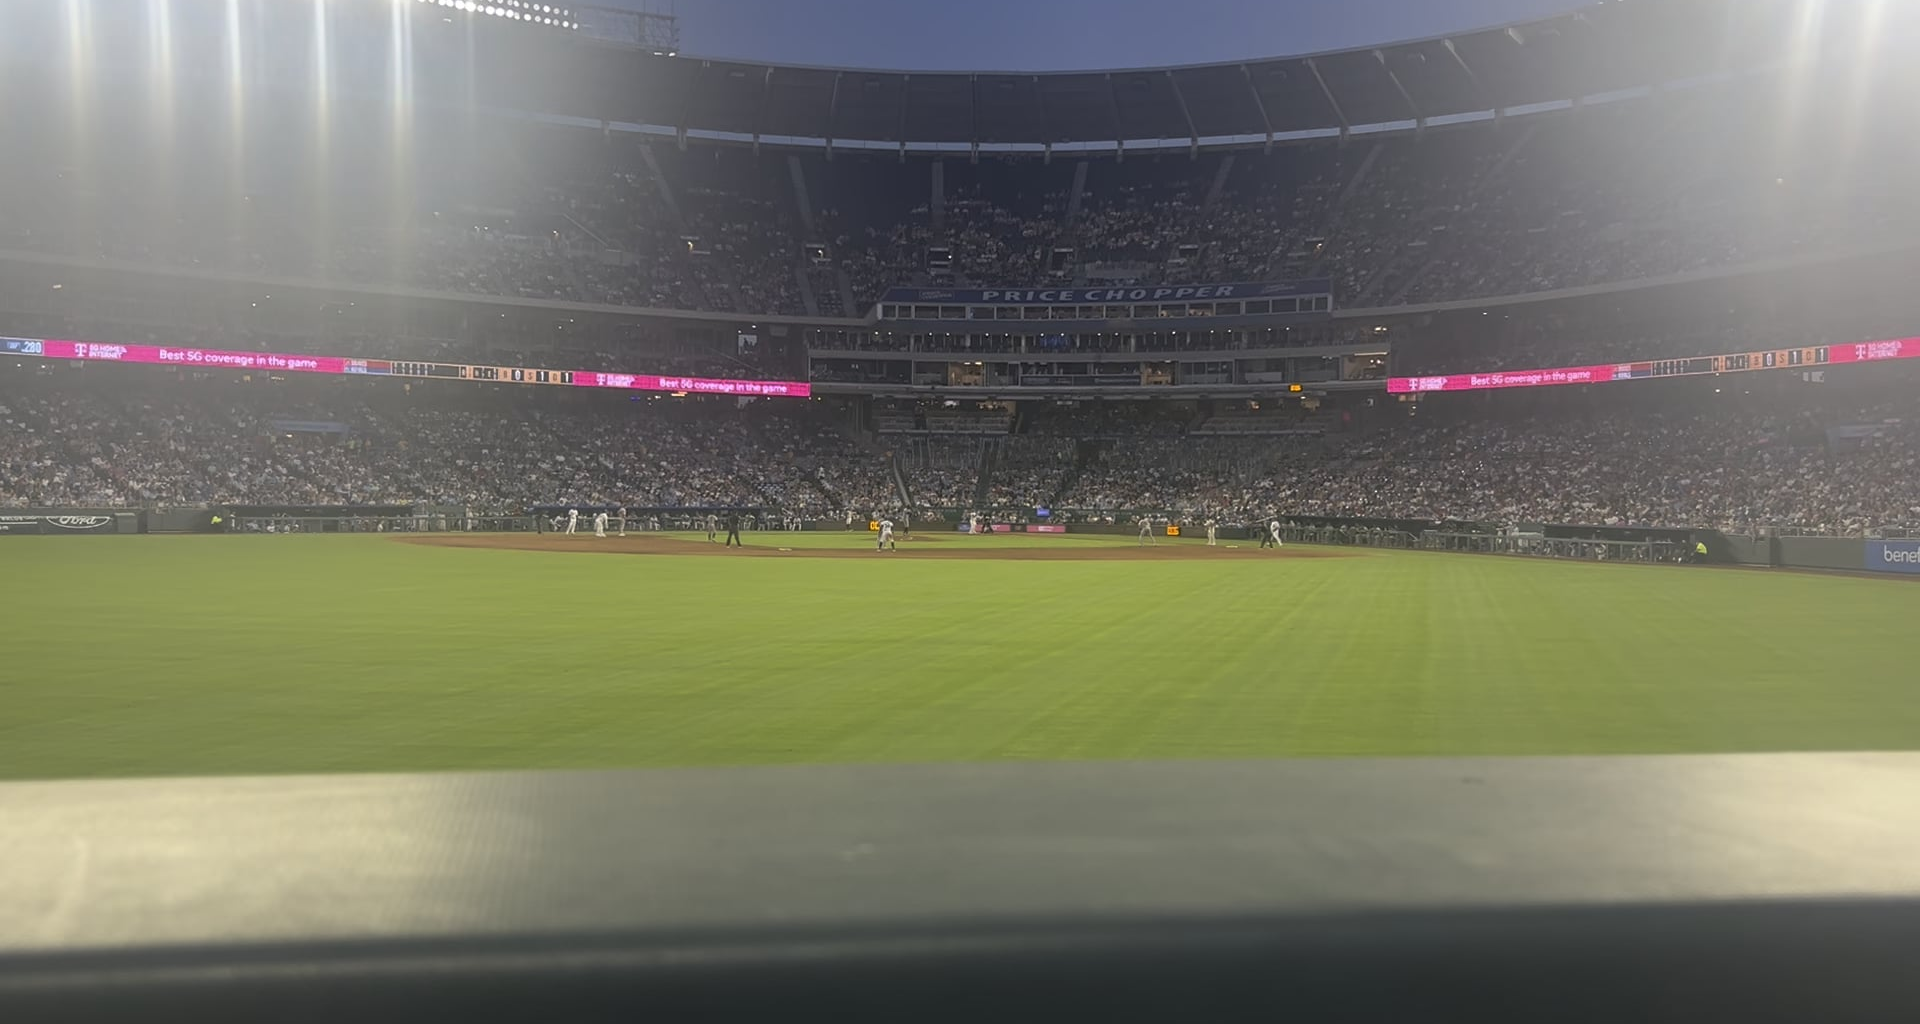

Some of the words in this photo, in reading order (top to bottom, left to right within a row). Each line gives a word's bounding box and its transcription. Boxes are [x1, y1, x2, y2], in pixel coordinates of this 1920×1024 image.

[982, 290, 1074, 301] PRICE
[1085, 285, 1235, 301] CHOPPER
[159, 349, 184, 360] Best
[187, 351, 202, 361] 5G
[204, 353, 254, 366] coverage
[256, 355, 266, 365] in
[267, 356, 285, 367] the
[287, 358, 317, 369] game
[659, 378, 679, 388] Best
[680, 379, 693, 389] 5G
[694, 381, 735, 393] coverage
[736, 382, 744, 391] in
[745, 382, 761, 392] the
[762, 384, 787, 394] game
[1471, 375, 1490, 386] Best
[1491, 375, 1503, 385] 5G
[1504, 374, 1542, 384] coverage
[1543, 372, 1551, 381] in
[1552, 371, 1566, 381] the
[1567, 370, 1591, 382] game
